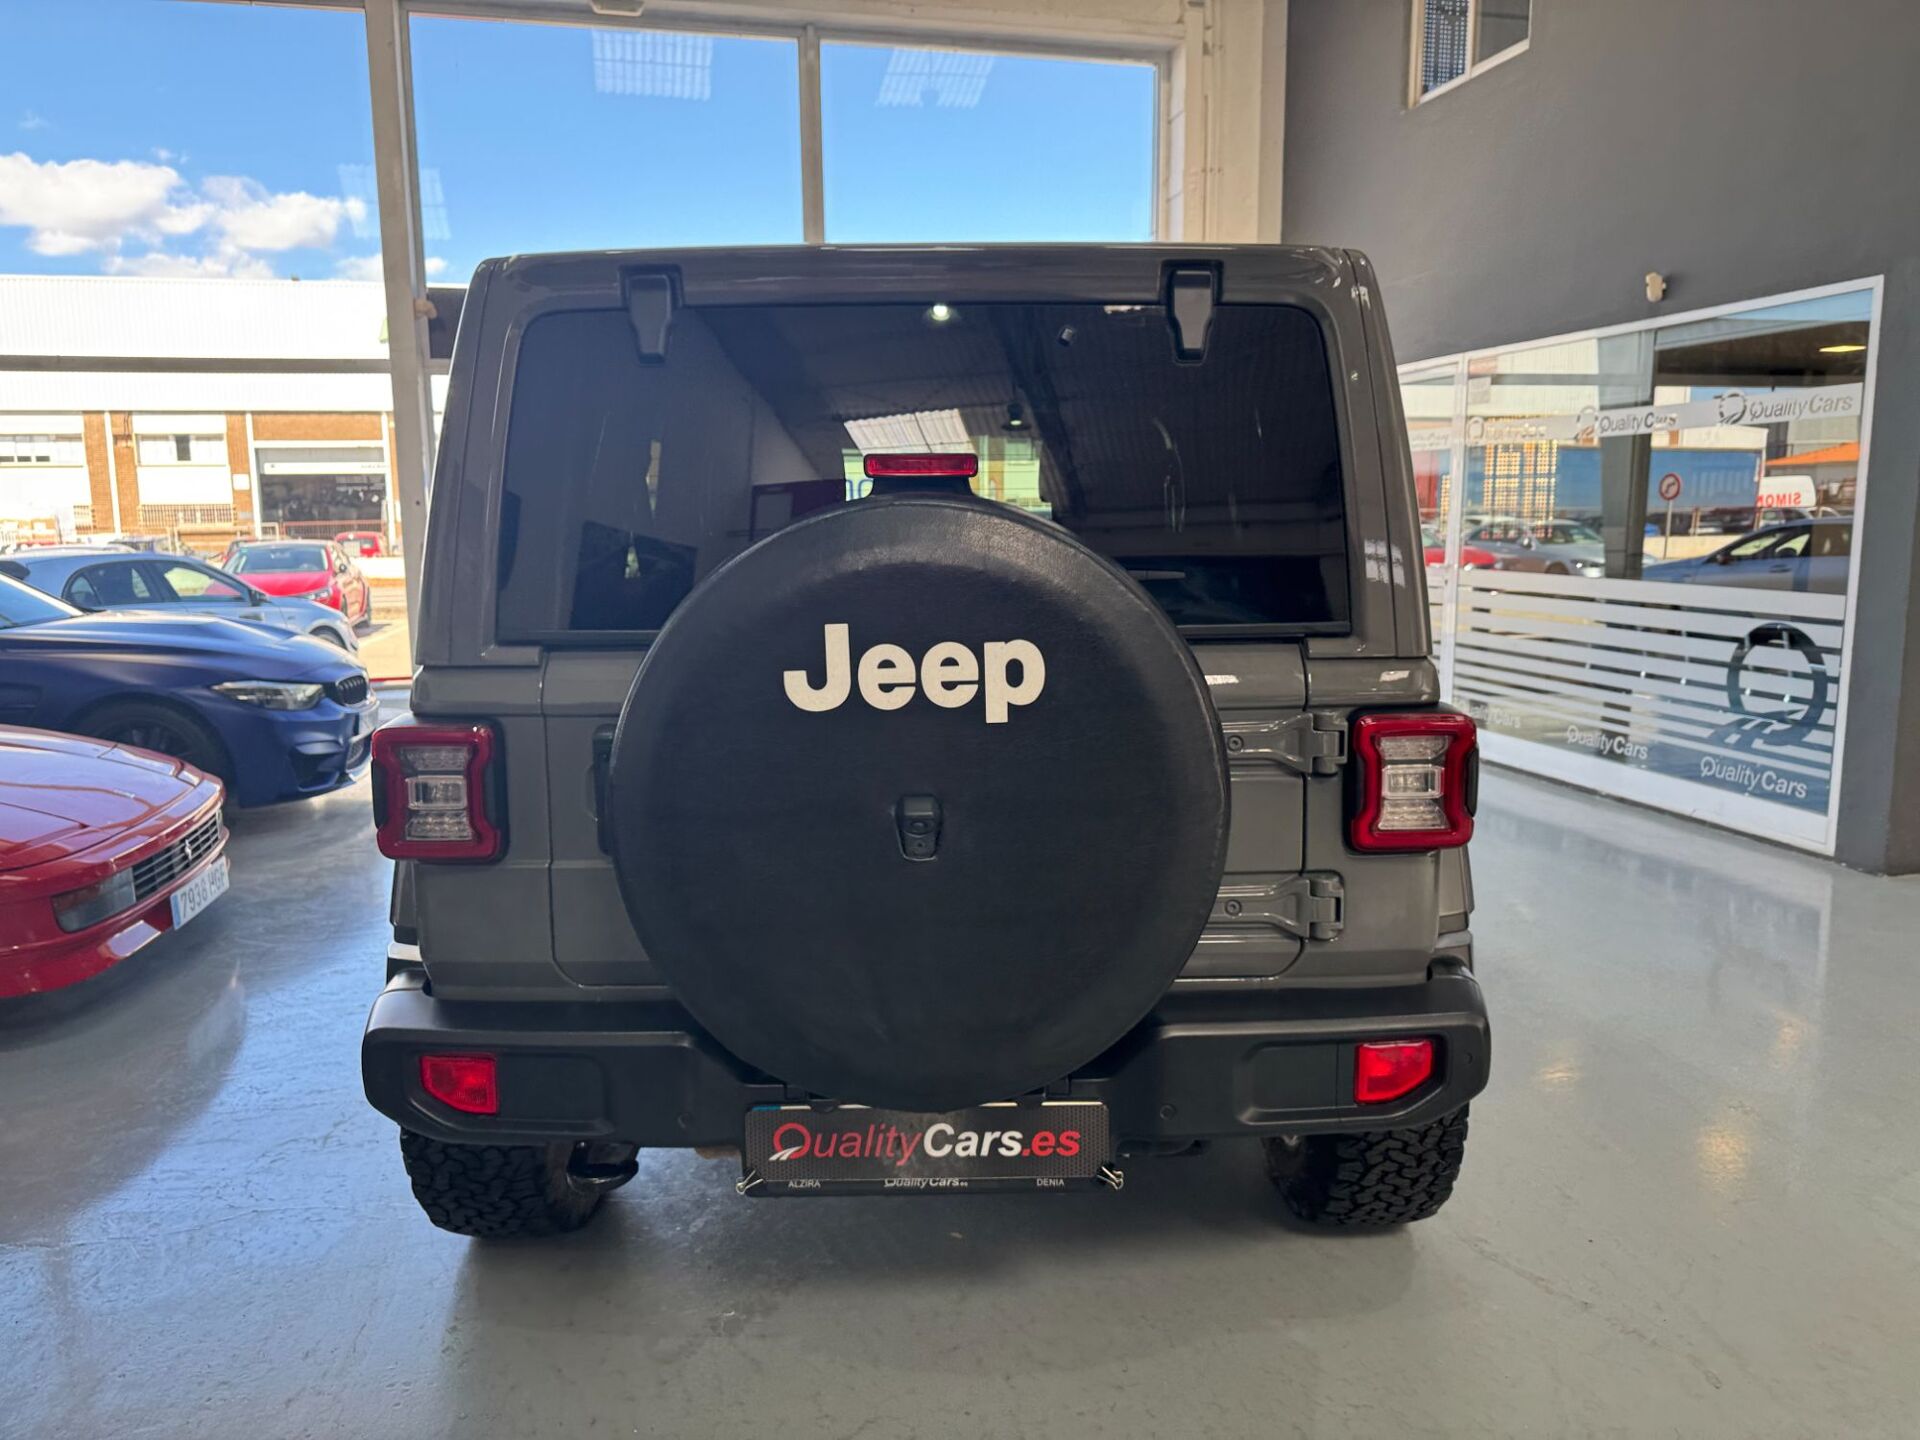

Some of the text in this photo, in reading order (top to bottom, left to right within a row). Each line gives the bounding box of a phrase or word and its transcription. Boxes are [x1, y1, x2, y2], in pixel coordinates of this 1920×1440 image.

[783, 623, 1046, 724] Jeep
[1700, 755, 1808, 799] QualityCars
[768, 1122, 1081, 1166] QualityCars.es
[788, 1179, 821, 1189] ALZIRA
